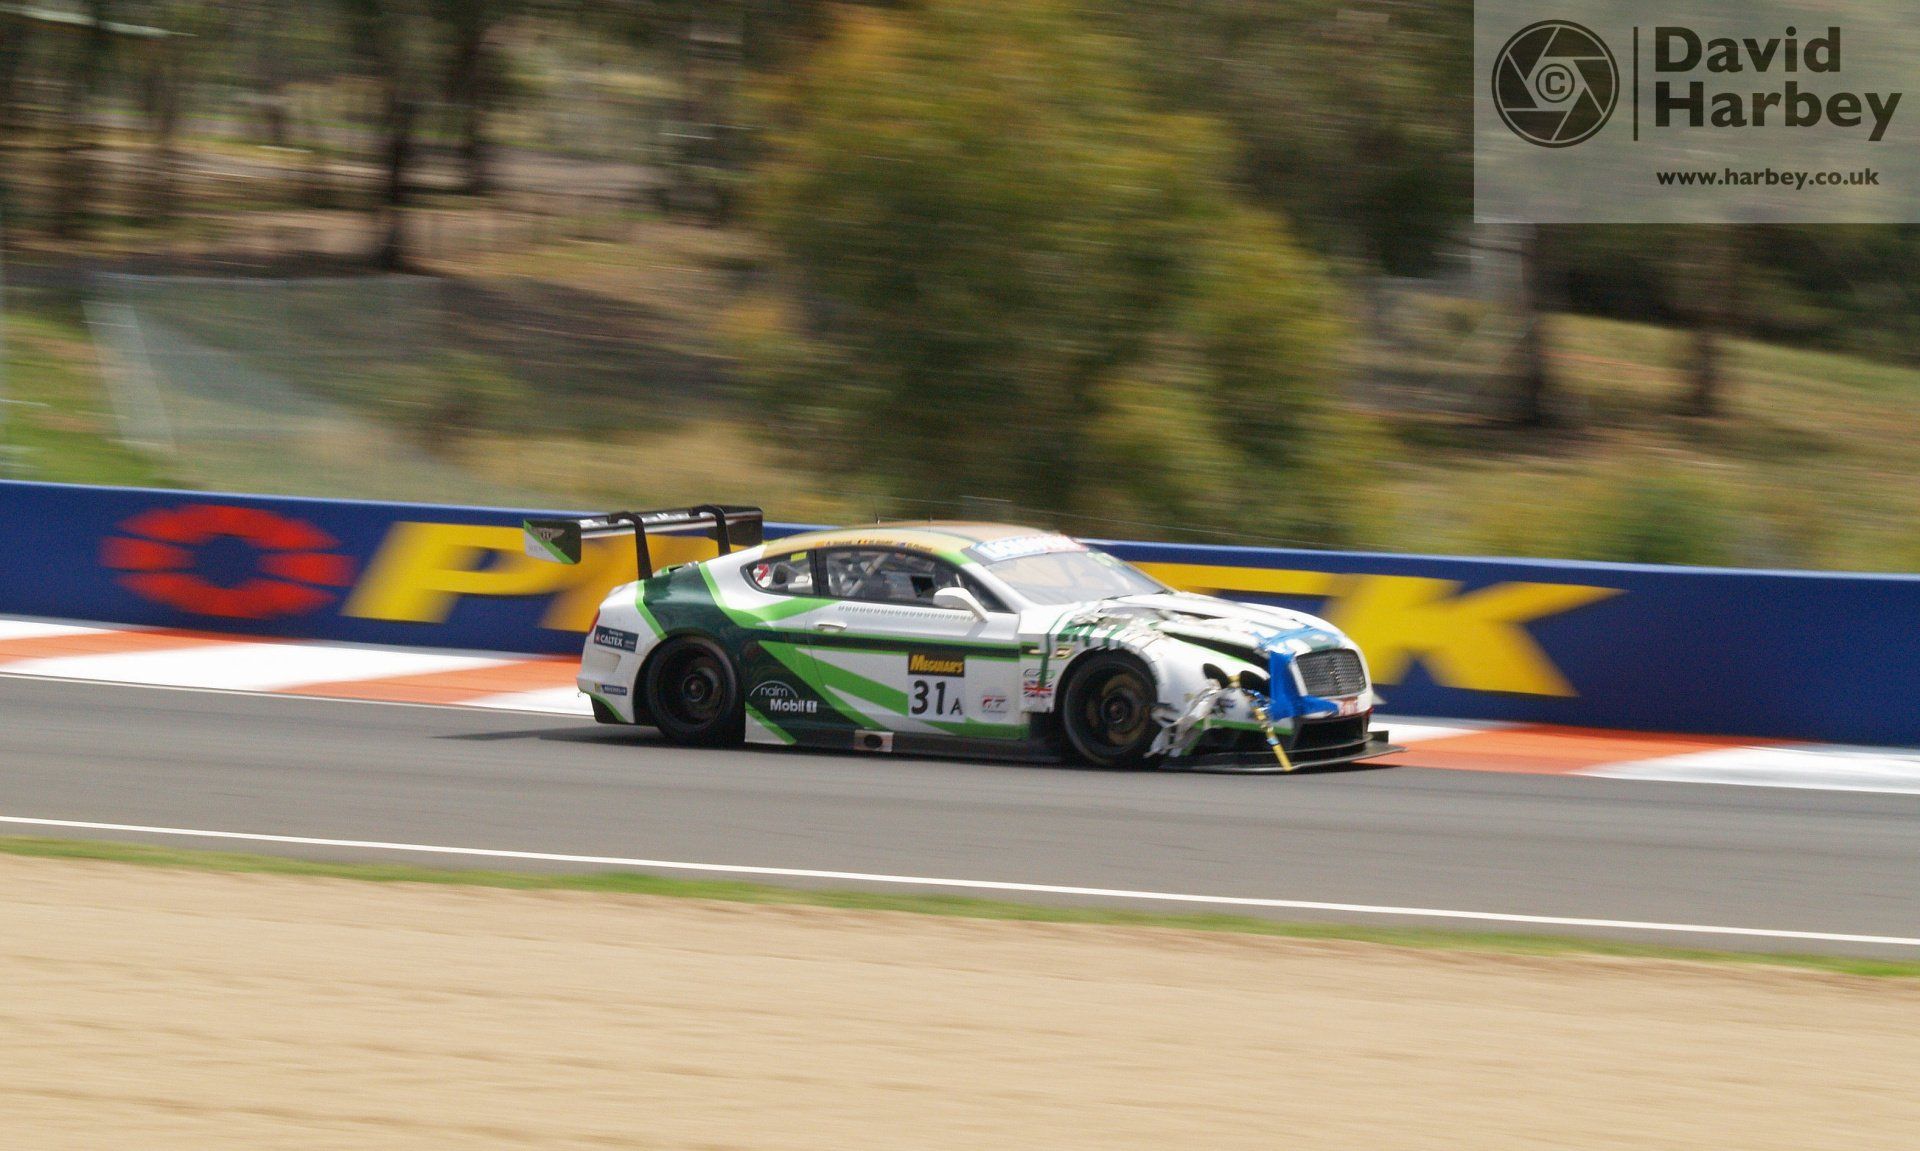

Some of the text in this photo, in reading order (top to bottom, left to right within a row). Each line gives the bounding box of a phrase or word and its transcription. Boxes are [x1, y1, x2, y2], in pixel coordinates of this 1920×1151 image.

[600, 634, 623, 647] CALTEX
[761, 685, 788, 697] naim
[770, 698, 805, 713] Mobil
